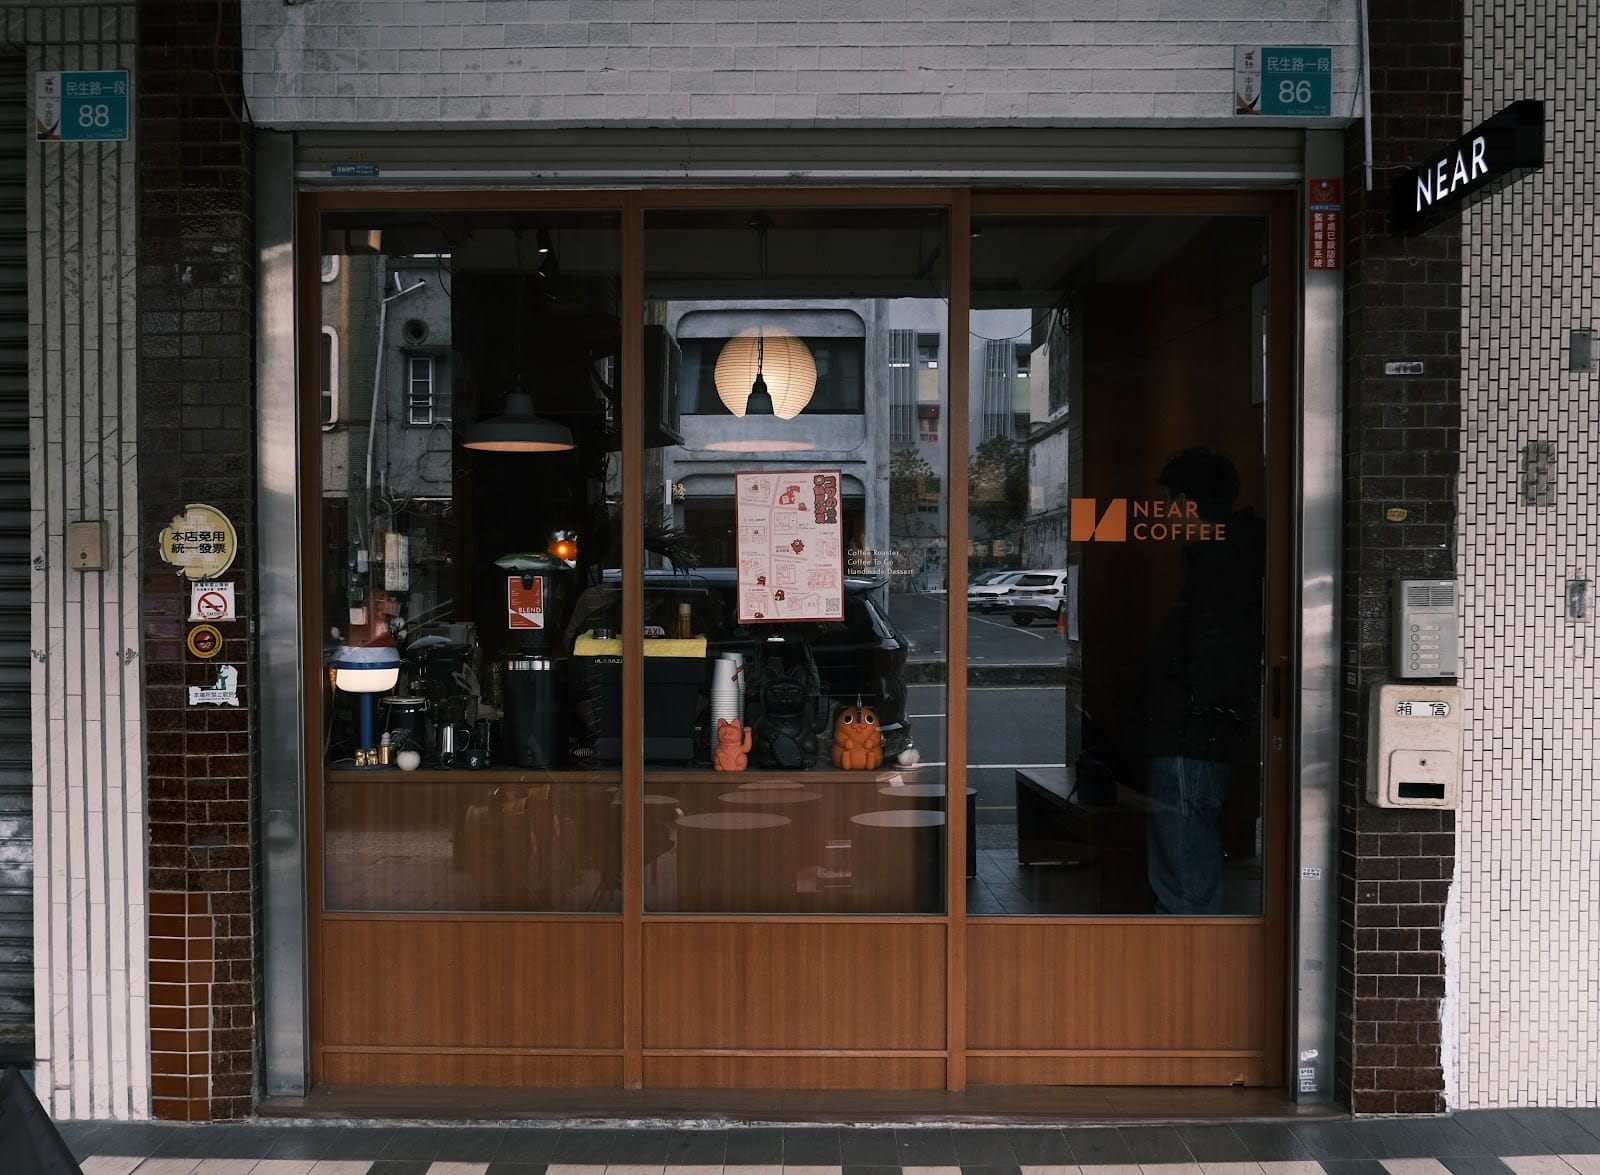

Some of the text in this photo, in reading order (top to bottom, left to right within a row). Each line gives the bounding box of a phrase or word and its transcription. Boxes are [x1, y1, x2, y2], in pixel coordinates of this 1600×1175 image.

[1267, 57, 1330, 72] 民生路一段
[66, 81, 126, 96] 民生路一段
[1279, 80, 1311, 103] 86
[79, 104, 110, 127] 88
[1416, 136, 1489, 213] NEAR
[1133, 501, 1199, 518] NEAR
[171, 530, 225, 542] 本店免用
[1133, 523, 1227, 541] COFFEE
[171, 543, 226, 554] 統一發票
[847, 558, 894, 566] Coffee To Go
